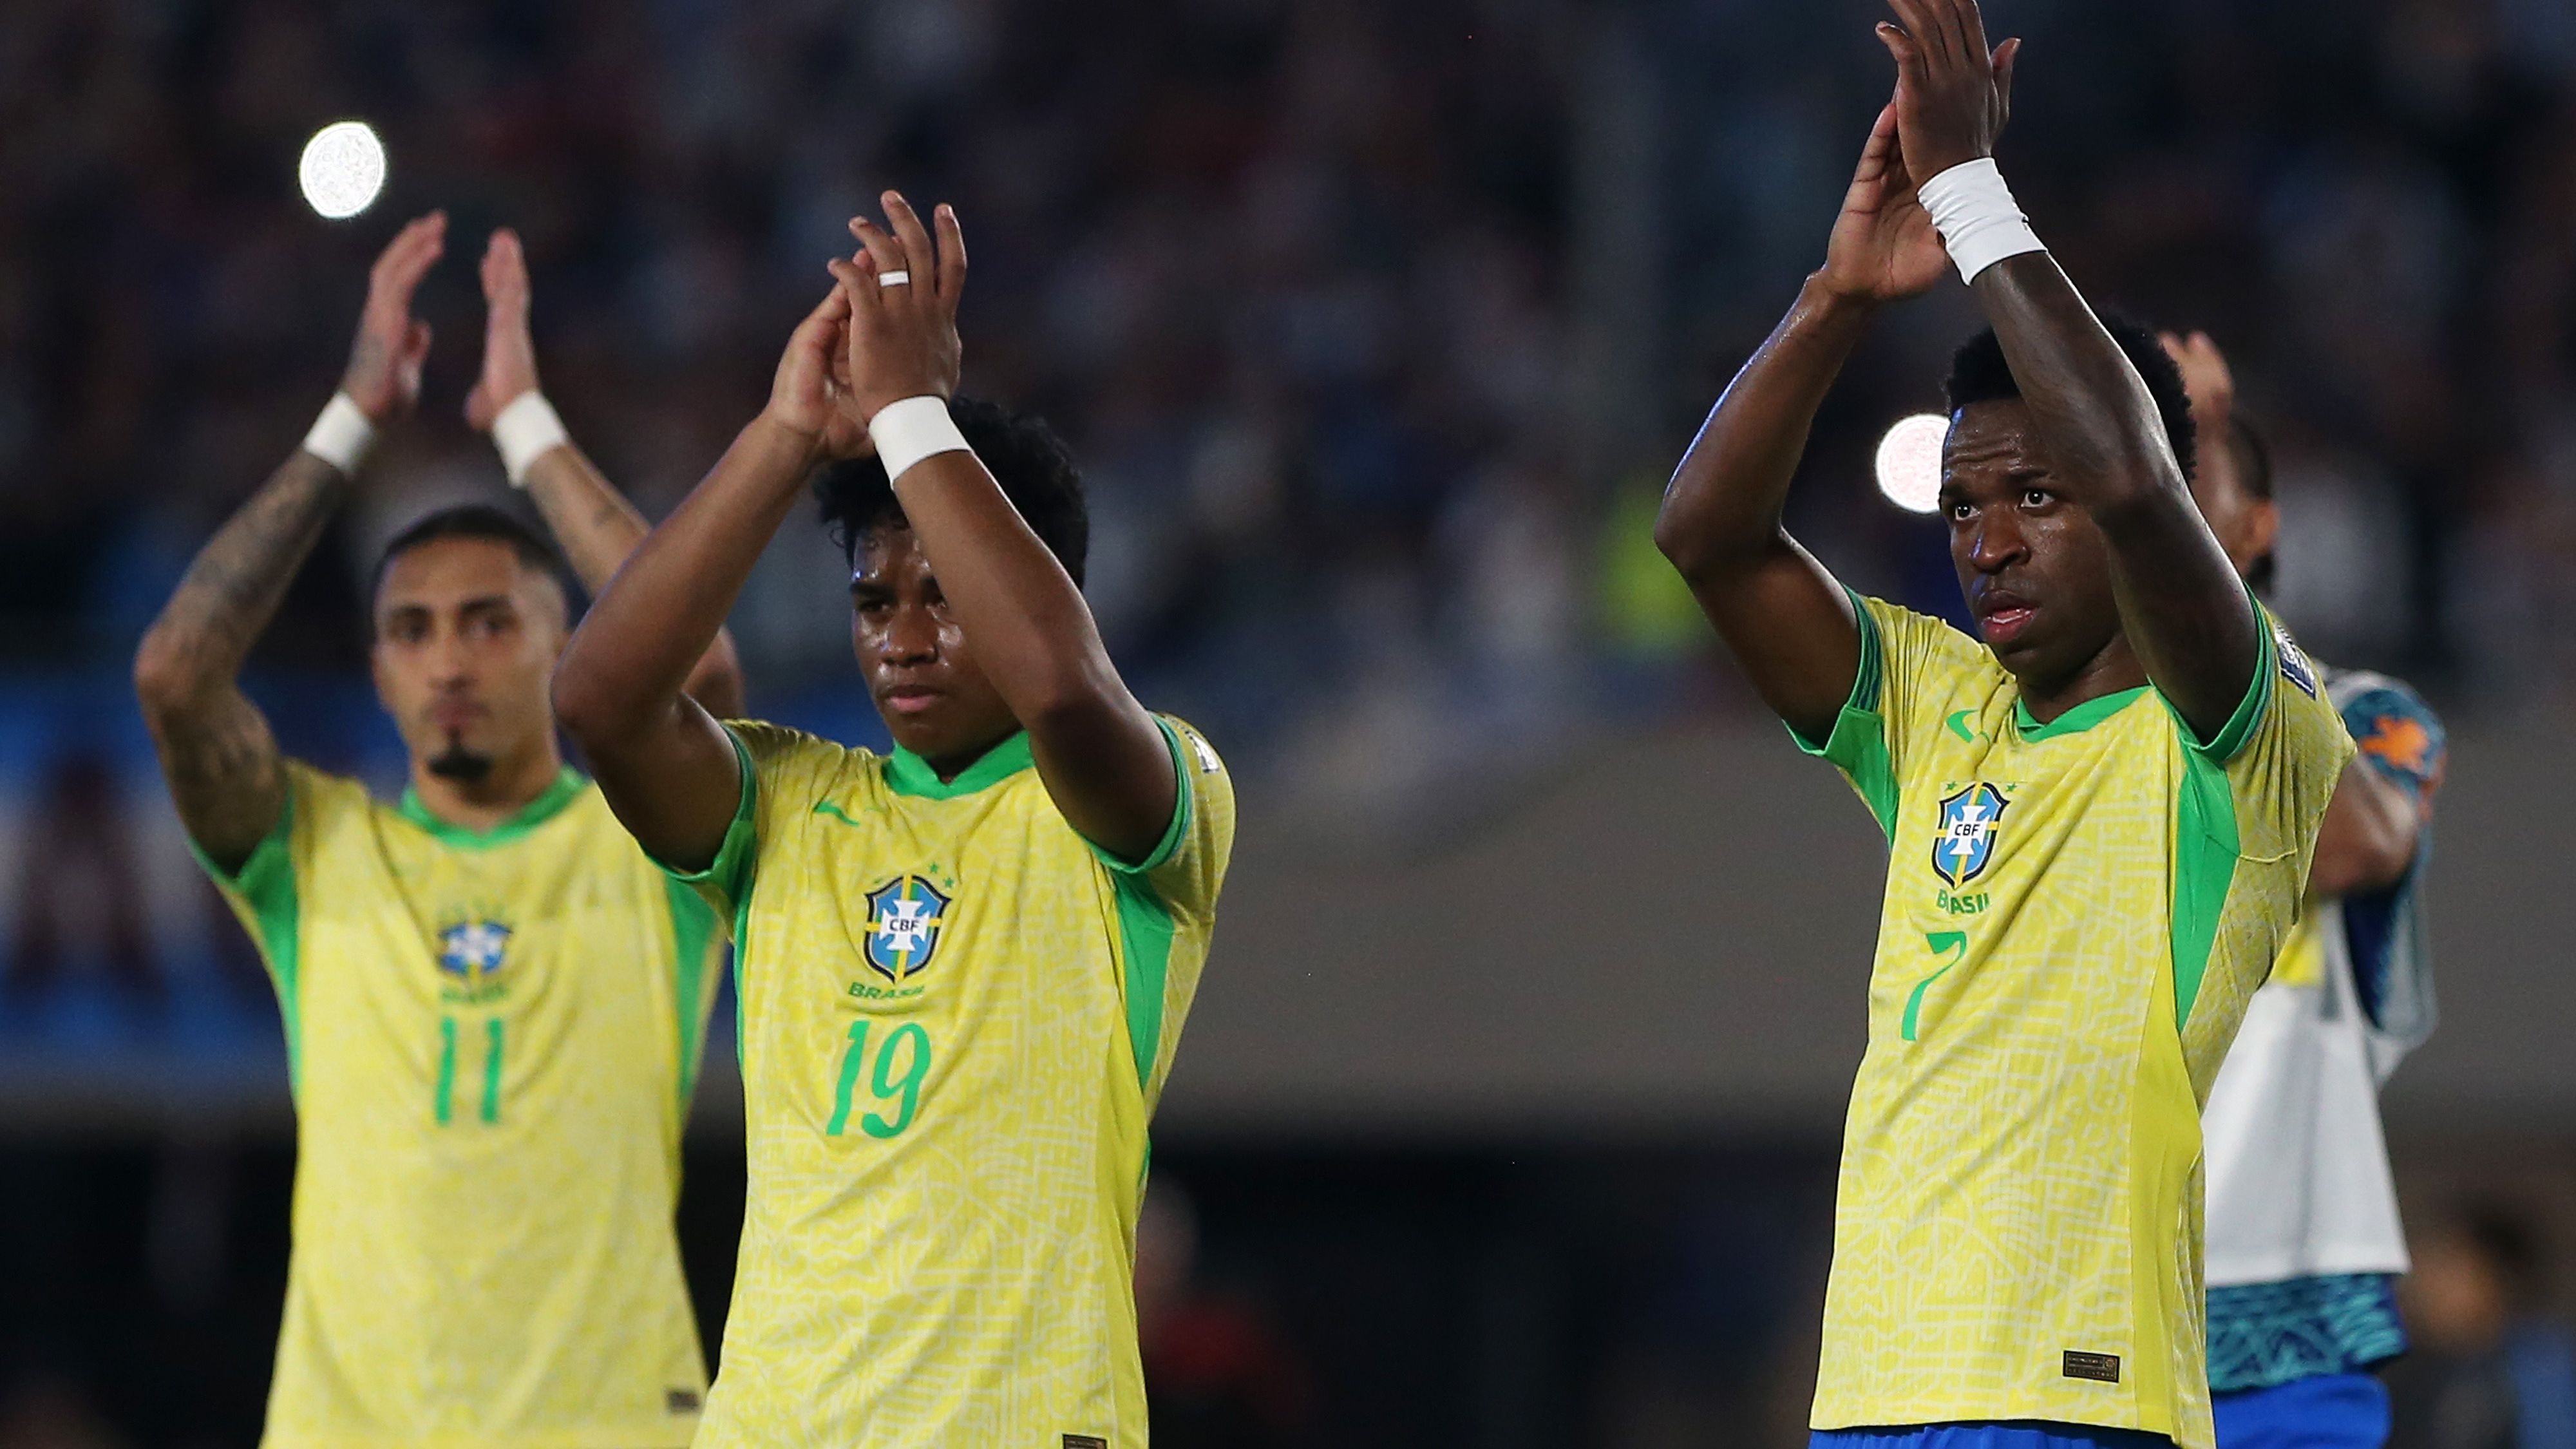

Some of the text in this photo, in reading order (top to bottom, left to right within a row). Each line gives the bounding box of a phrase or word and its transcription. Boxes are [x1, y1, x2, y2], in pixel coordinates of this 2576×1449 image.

[1955, 824, 1980, 836] CBF
[1937, 889, 1990, 914] BASIL
[889, 919, 919, 932] CBF
[848, 982, 925, 999] BRA
[1901, 931, 1967, 1041] 7
[436, 1016, 504, 1121] 11
[826, 1020, 931, 1139] 19
